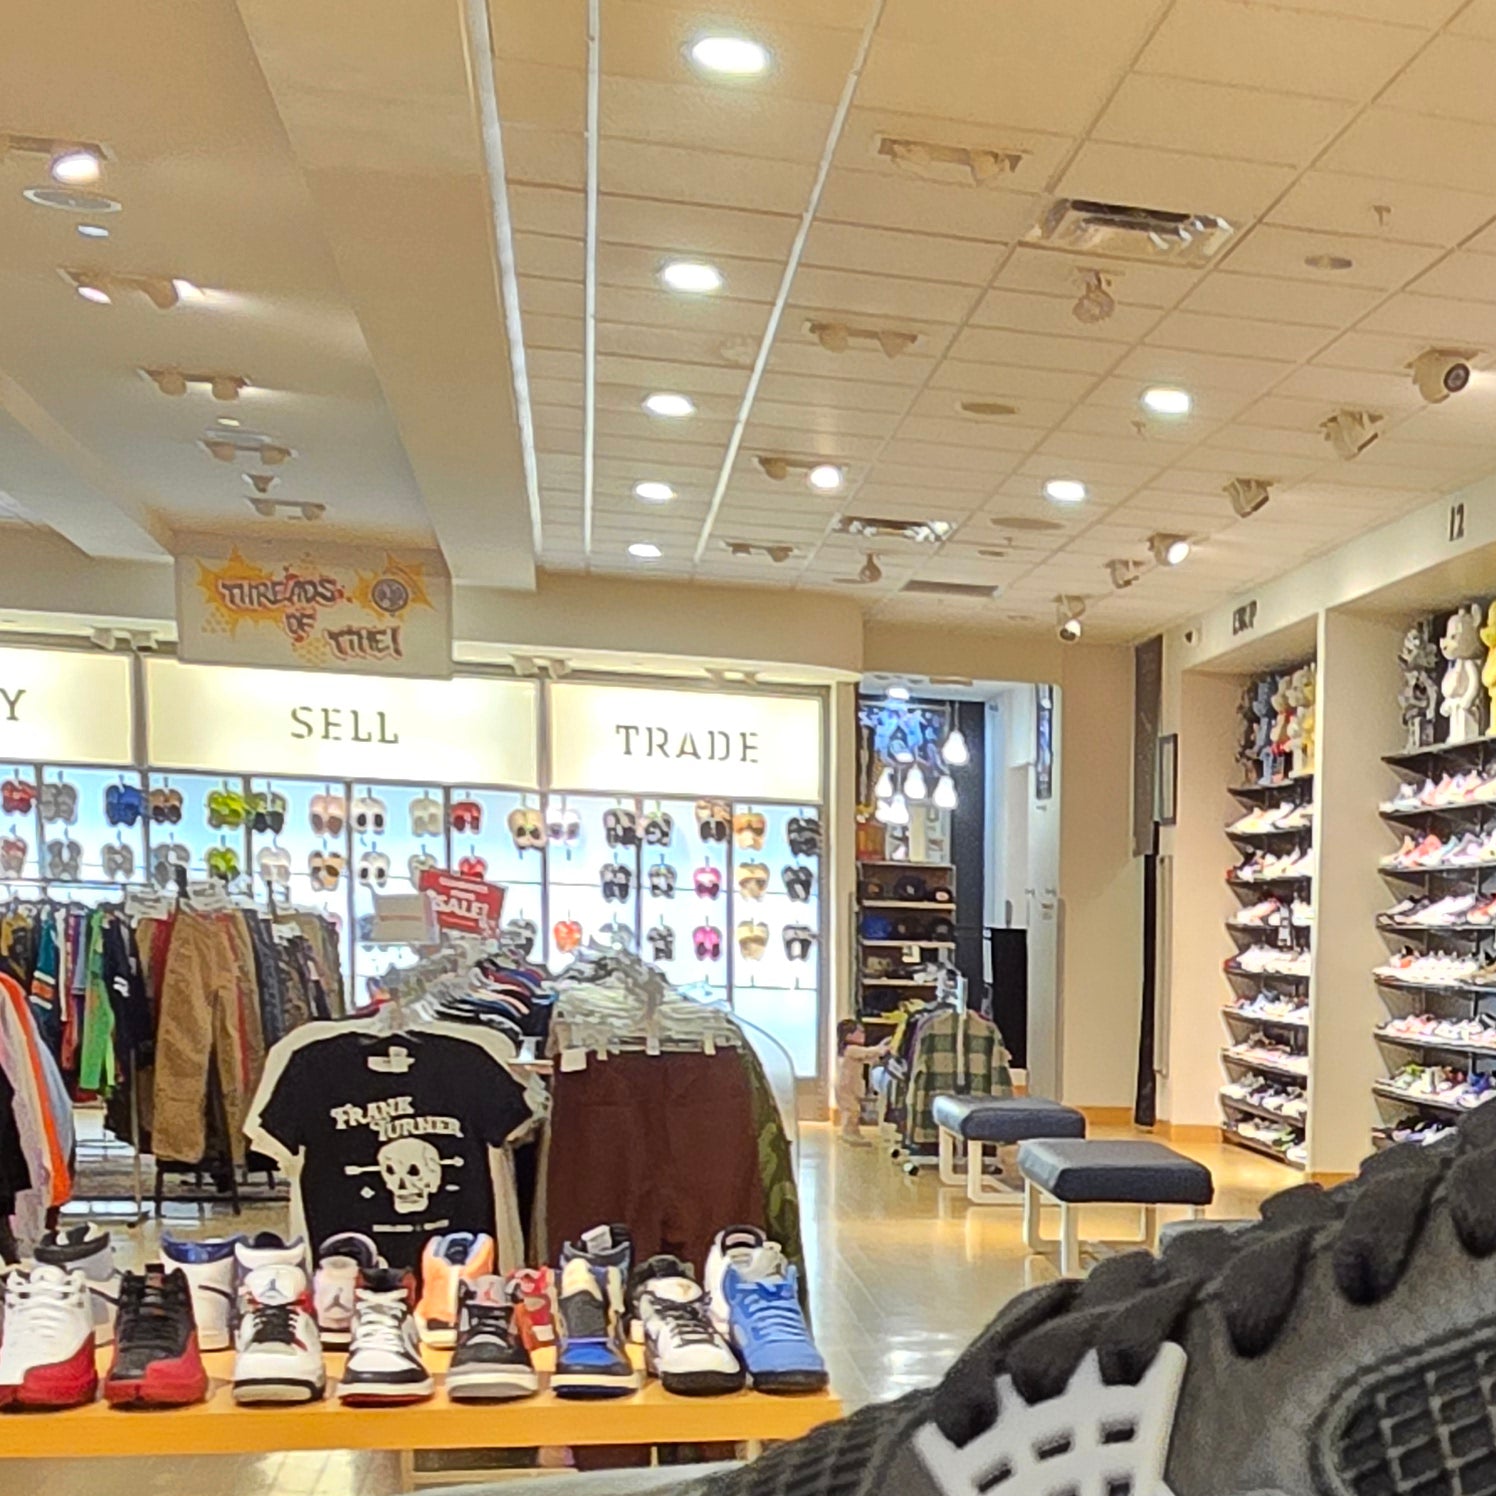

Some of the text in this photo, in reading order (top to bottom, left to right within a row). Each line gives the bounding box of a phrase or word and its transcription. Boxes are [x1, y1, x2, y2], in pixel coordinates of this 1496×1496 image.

[219, 575, 340, 608] THREADS
[285, 610, 317, 636] OF
[290, 705, 400, 745] SELL
[615, 724, 759, 764] TRADE
[329, 1096, 415, 1130] FRANK
[369, 1116, 464, 1142] TURNER
